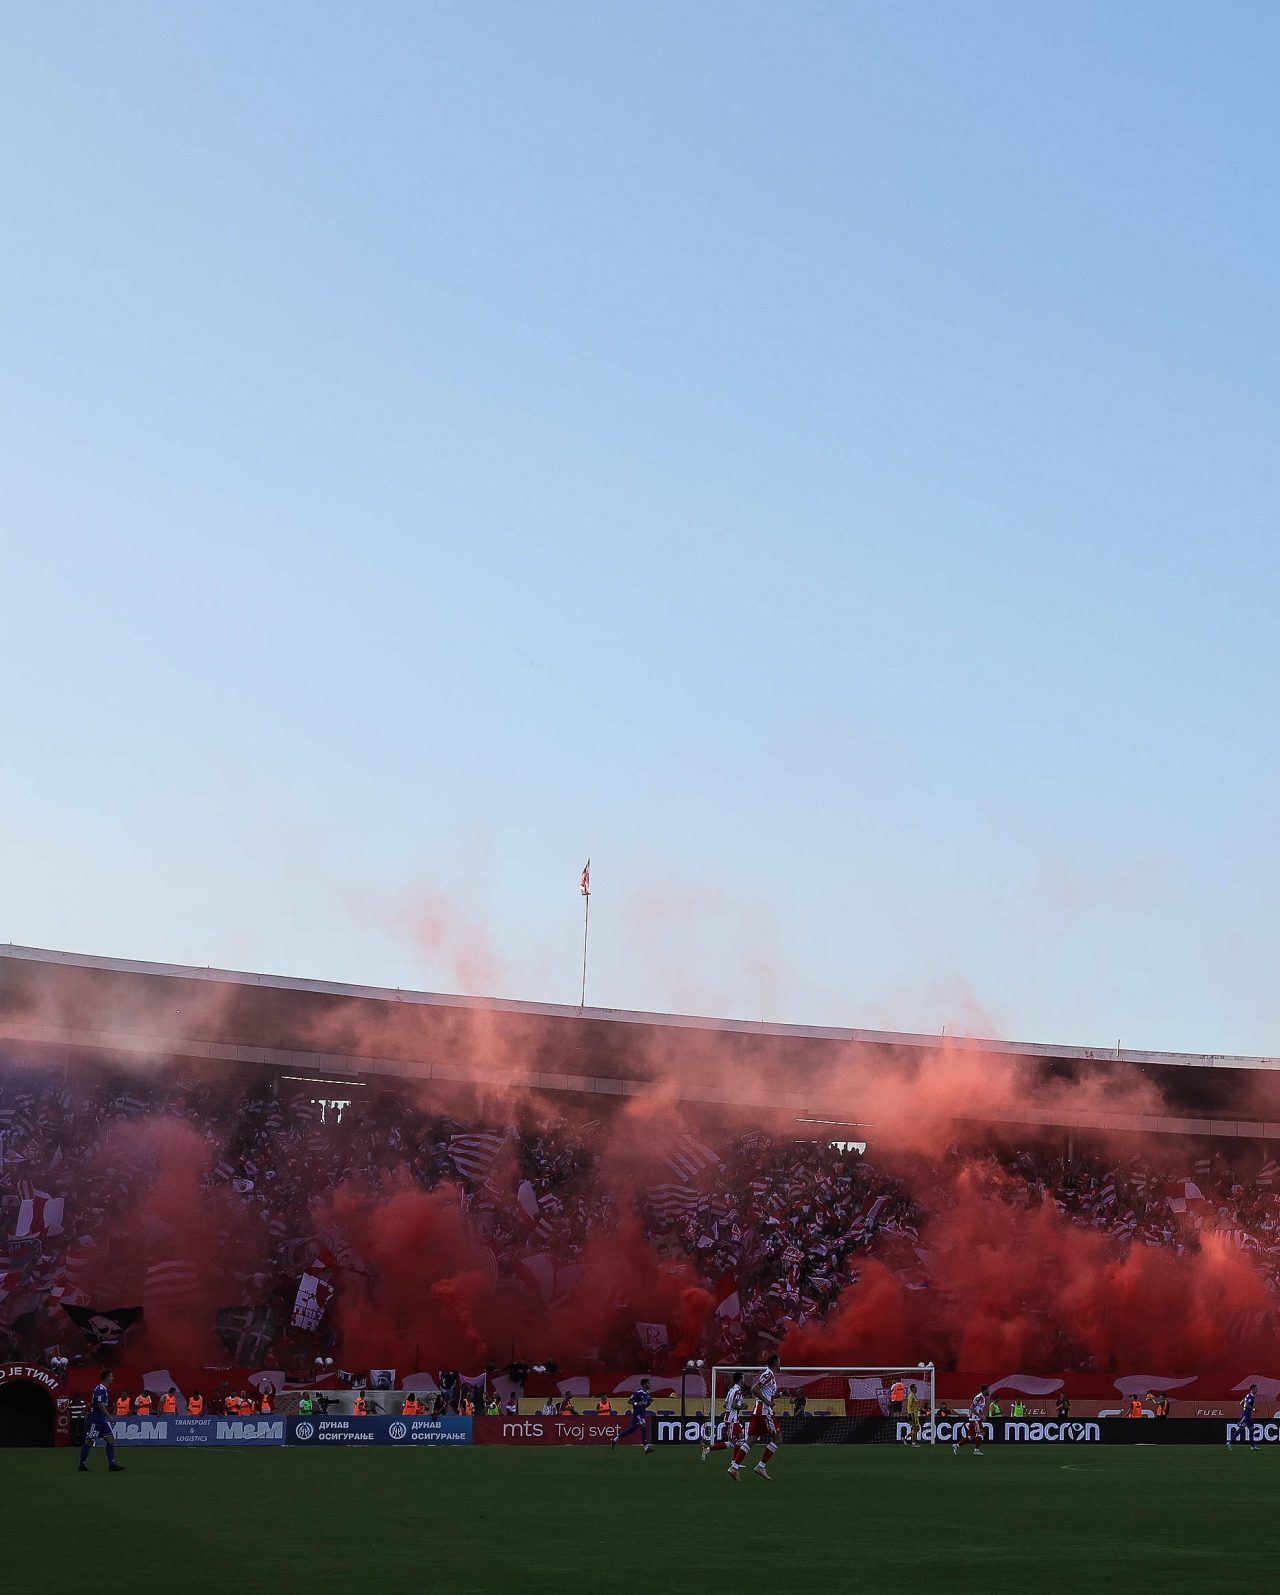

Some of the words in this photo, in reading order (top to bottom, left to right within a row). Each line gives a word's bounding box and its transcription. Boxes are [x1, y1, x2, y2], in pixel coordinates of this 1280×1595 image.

[319, 1421, 350, 1430] ДУНАВ
[411, 1421, 442, 1430] ДУНАВ
[503, 1420, 544, 1437] mts
[555, 1423, 585, 1440] Tvoj
[589, 1423, 621, 1437] svet
[216, 1421, 283, 1440] M&M
[1004, 1422, 1100, 1441] macron
[318, 1432, 374, 1440] ОСИГУРАЊЕ
[411, 1432, 466, 1440] ОСИГУРАЊЕ
